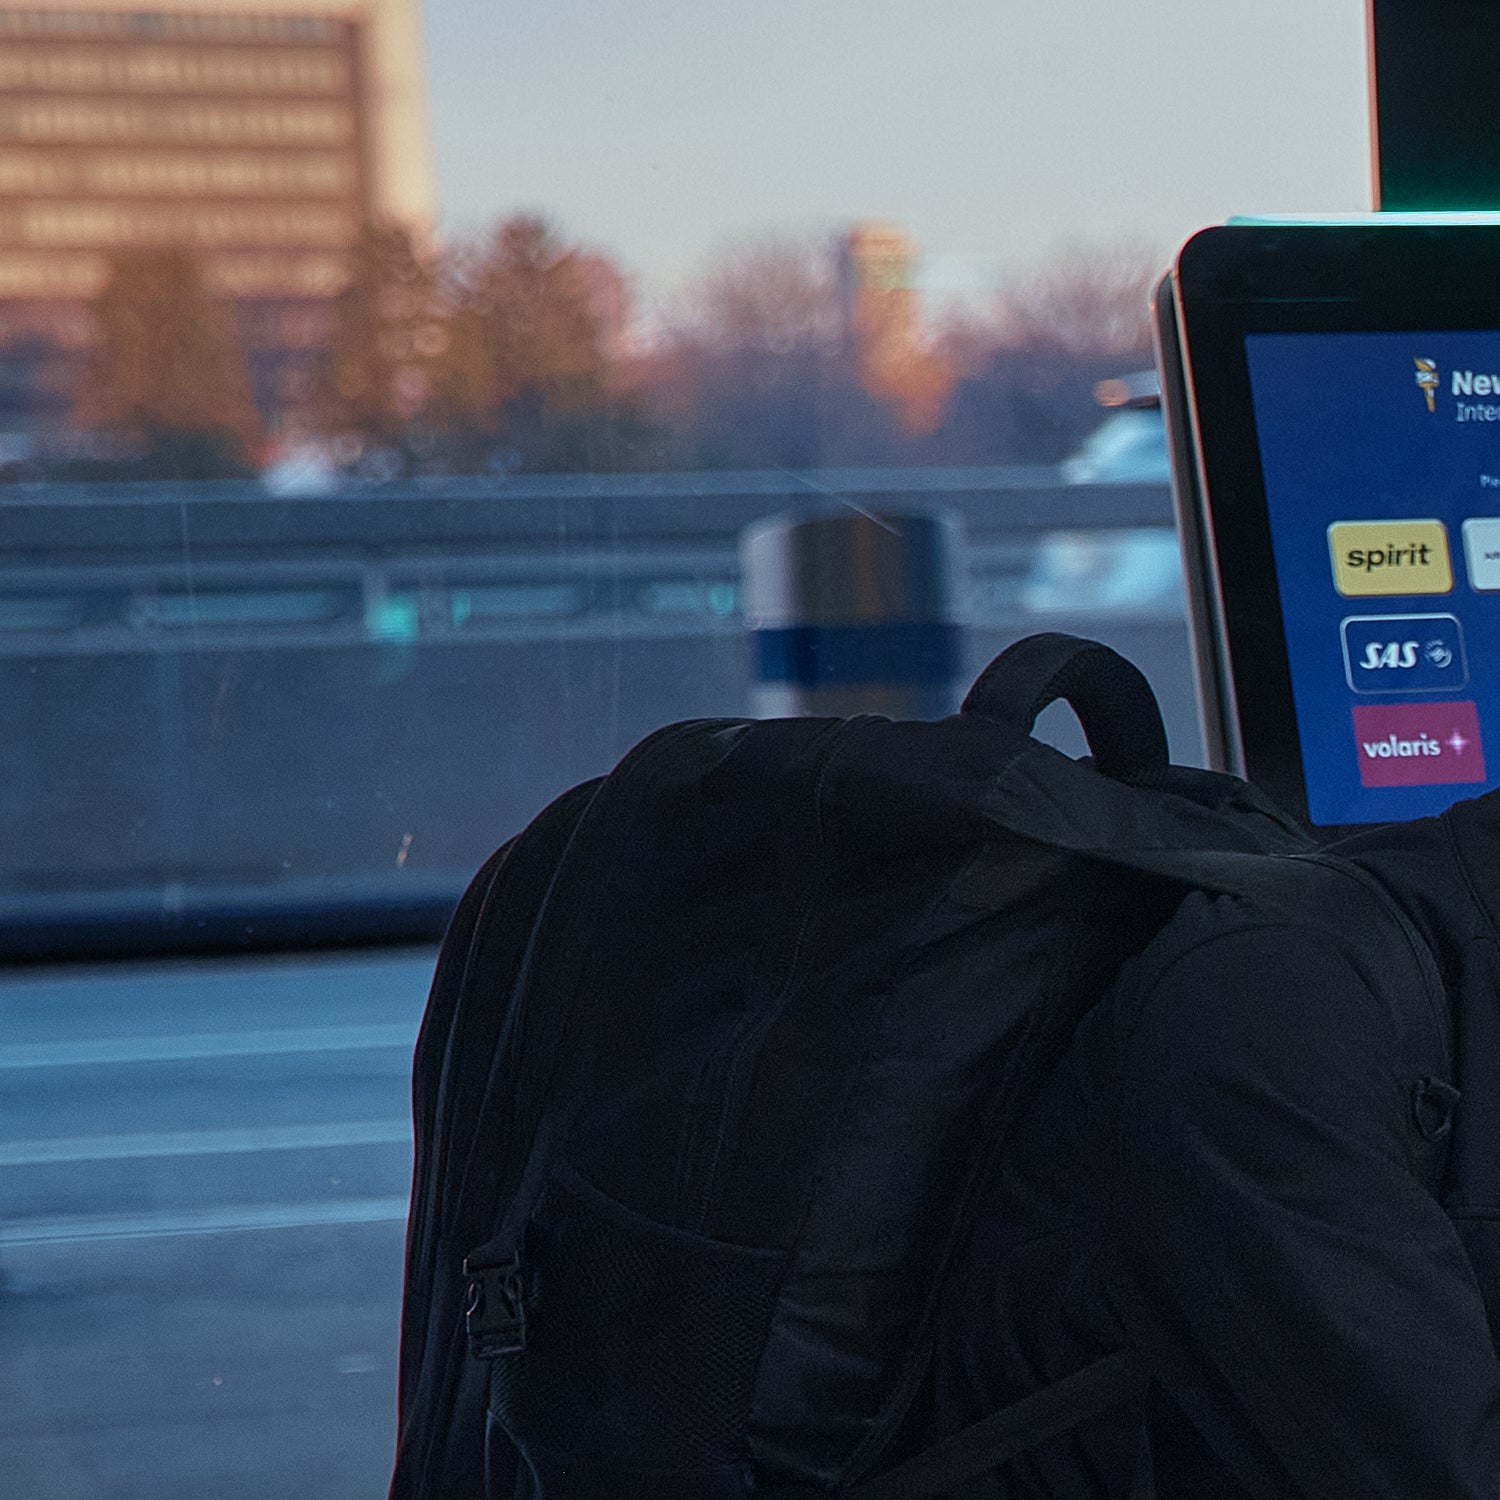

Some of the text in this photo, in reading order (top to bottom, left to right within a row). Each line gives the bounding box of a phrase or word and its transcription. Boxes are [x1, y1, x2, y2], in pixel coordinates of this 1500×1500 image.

[1346, 542, 1432, 573] spirit
[1360, 640, 1420, 669] SAS
[1363, 732, 1441, 758] volaris
